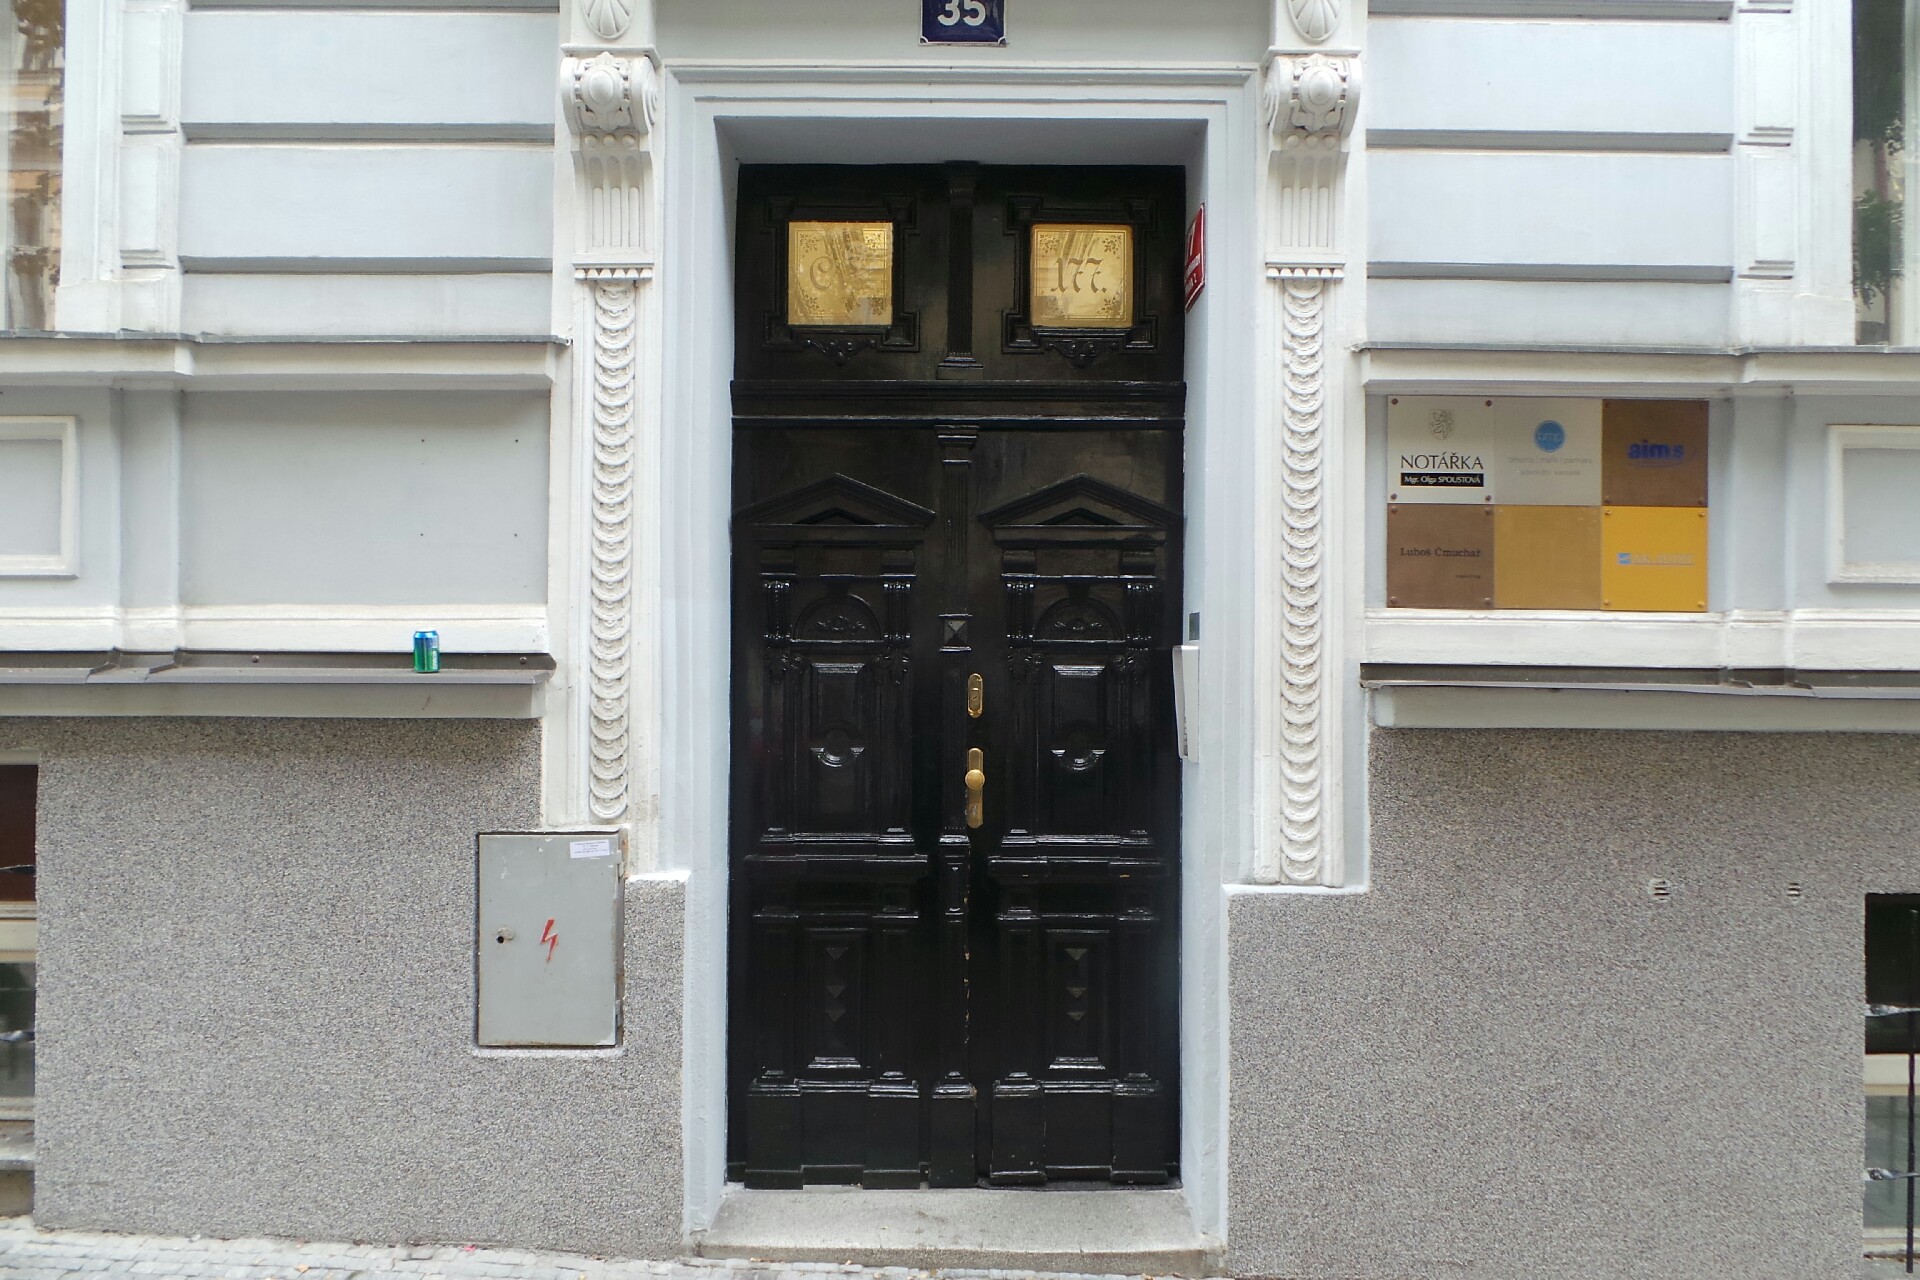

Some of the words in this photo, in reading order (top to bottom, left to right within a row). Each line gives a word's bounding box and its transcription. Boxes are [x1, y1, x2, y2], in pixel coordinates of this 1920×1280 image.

[937, 0, 986, 26] 35
[1400, 452, 1484, 470] NOTÁŘKA
[1404, 475, 1419, 484] Mgr.
[1420, 475, 1437, 484] Olga
[1438, 475, 1481, 484] SPOUSTOVÁ
[1400, 547, 1431, 556] Luboš
